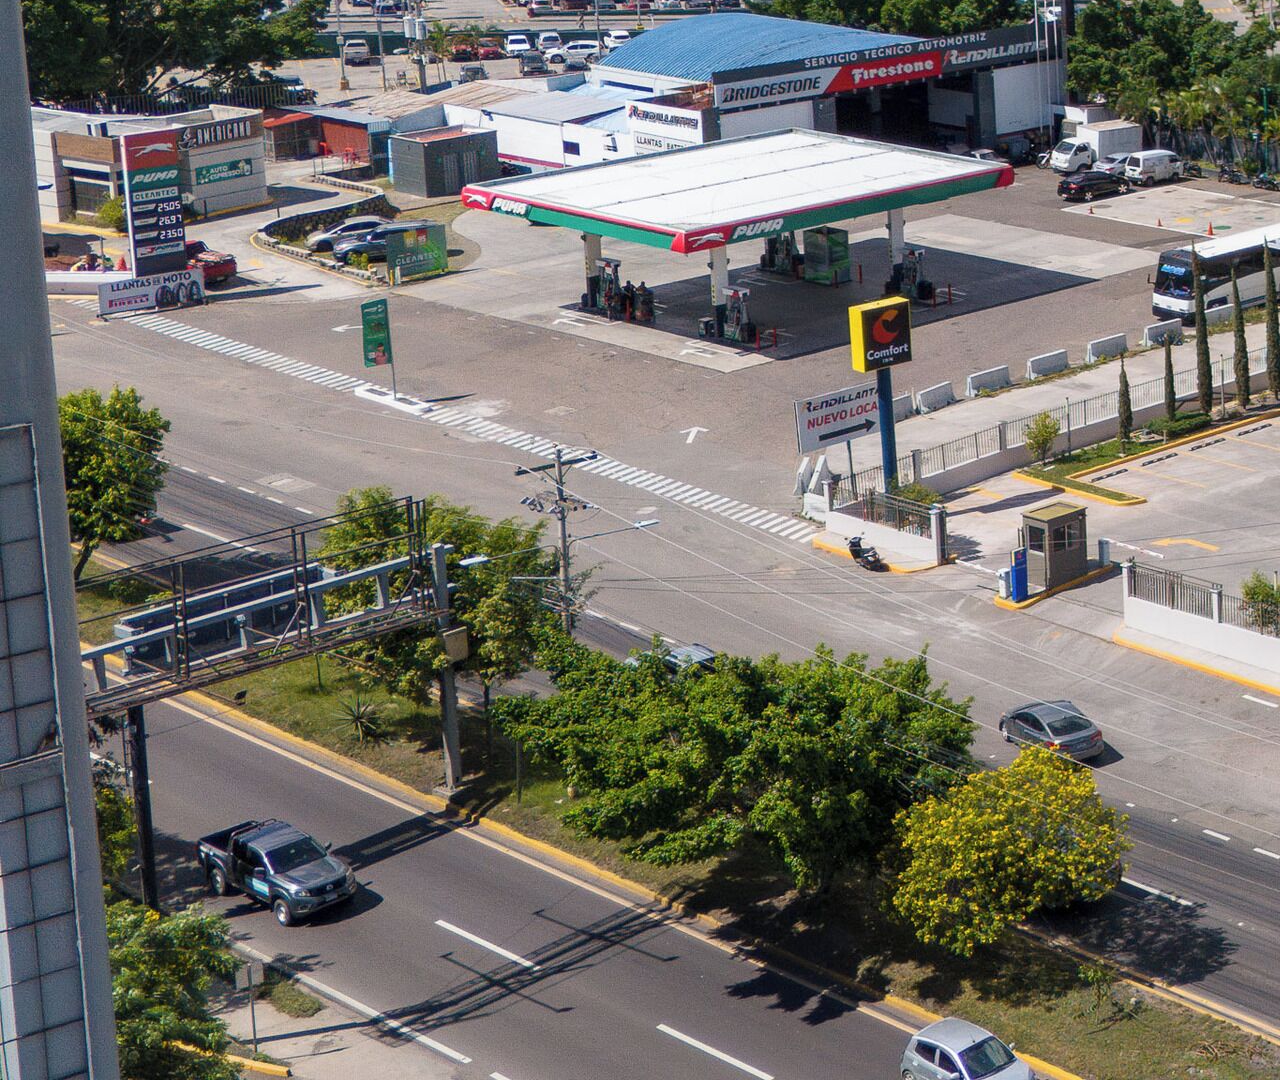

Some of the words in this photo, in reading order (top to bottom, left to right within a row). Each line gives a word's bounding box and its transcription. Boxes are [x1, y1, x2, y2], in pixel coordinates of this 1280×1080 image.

[804, 51, 858, 68] SERVICIO
[864, 44, 912, 60] TECNICO
[918, 32, 986, 52] AUTOMOTRIZ
[851, 59, 934, 84] Firestone
[722, 76, 821, 104] BRIDGESTONE
[636, 136, 662, 148] LLANTAS
[131, 169, 178, 185] PUMA
[210, 165, 229, 174] AUTO
[491, 197, 528, 216] PUMA
[733, 218, 784, 240] PUMA
[111, 278, 151, 292] LLANTAS
[162, 271, 192, 284] MOTO
[867, 343, 909, 361] Comfort
[807, 409, 848, 430] NUEVO
[849, 400, 878, 418] LOCA
